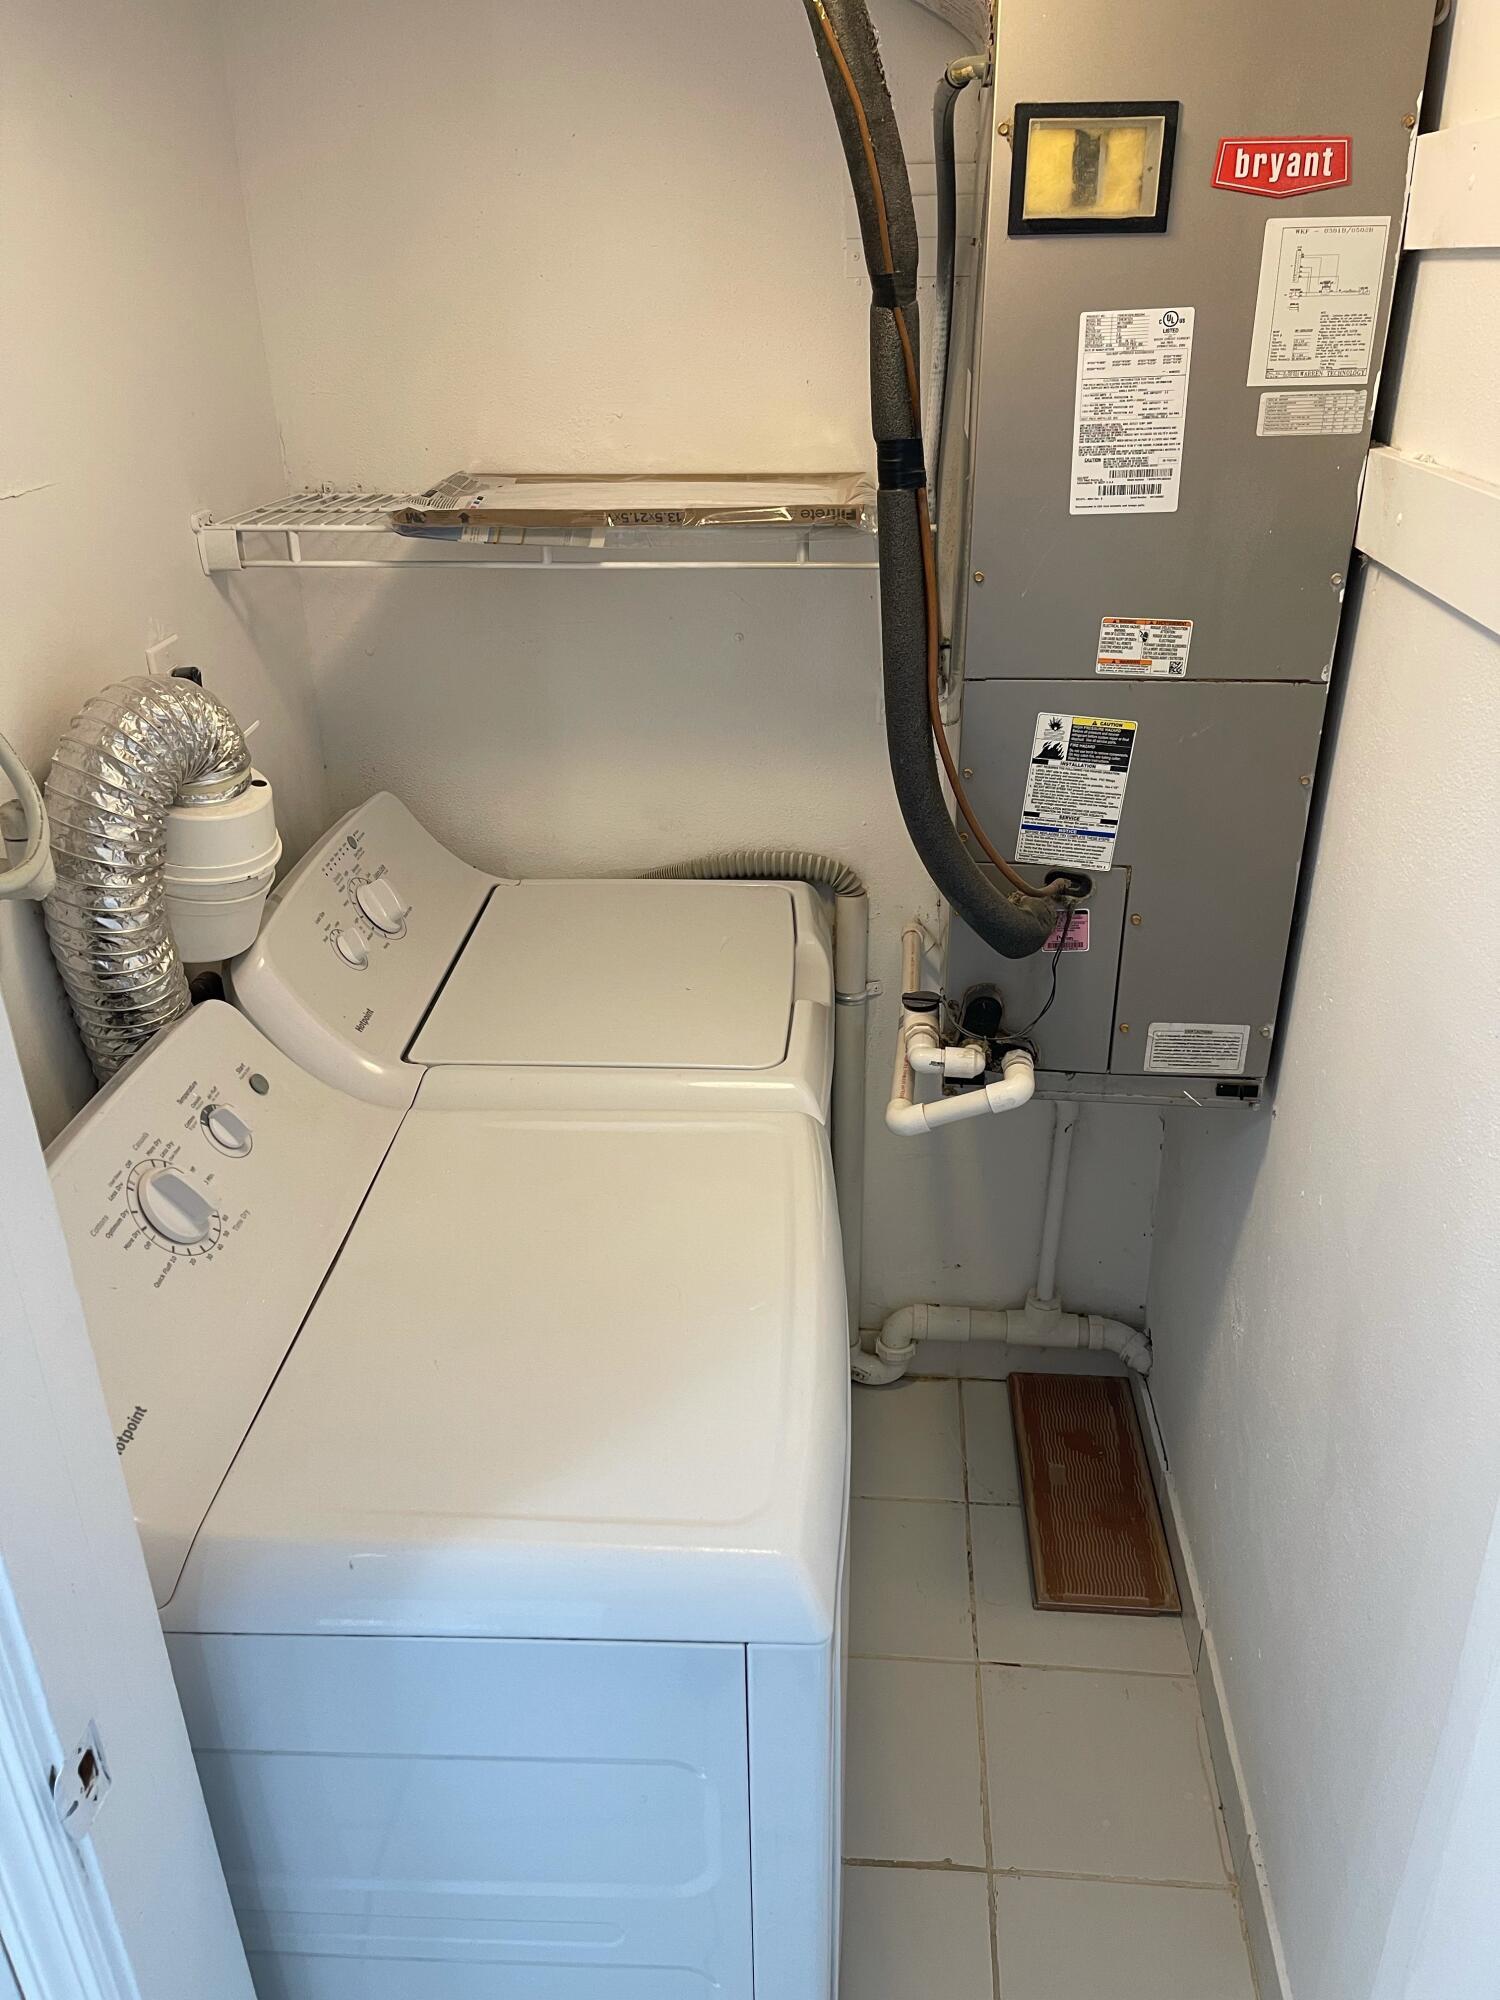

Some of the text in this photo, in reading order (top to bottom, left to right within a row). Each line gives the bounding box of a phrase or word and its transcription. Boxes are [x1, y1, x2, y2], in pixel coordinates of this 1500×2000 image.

[1235, 147, 1334, 183] bryant
[800, 508, 857, 522] Filtrete
[1060, 761, 1097, 769] INSTALLATION
[354, 1008, 375, 1032] Hotpoint
[116, 1406, 148, 1456] otpoint
